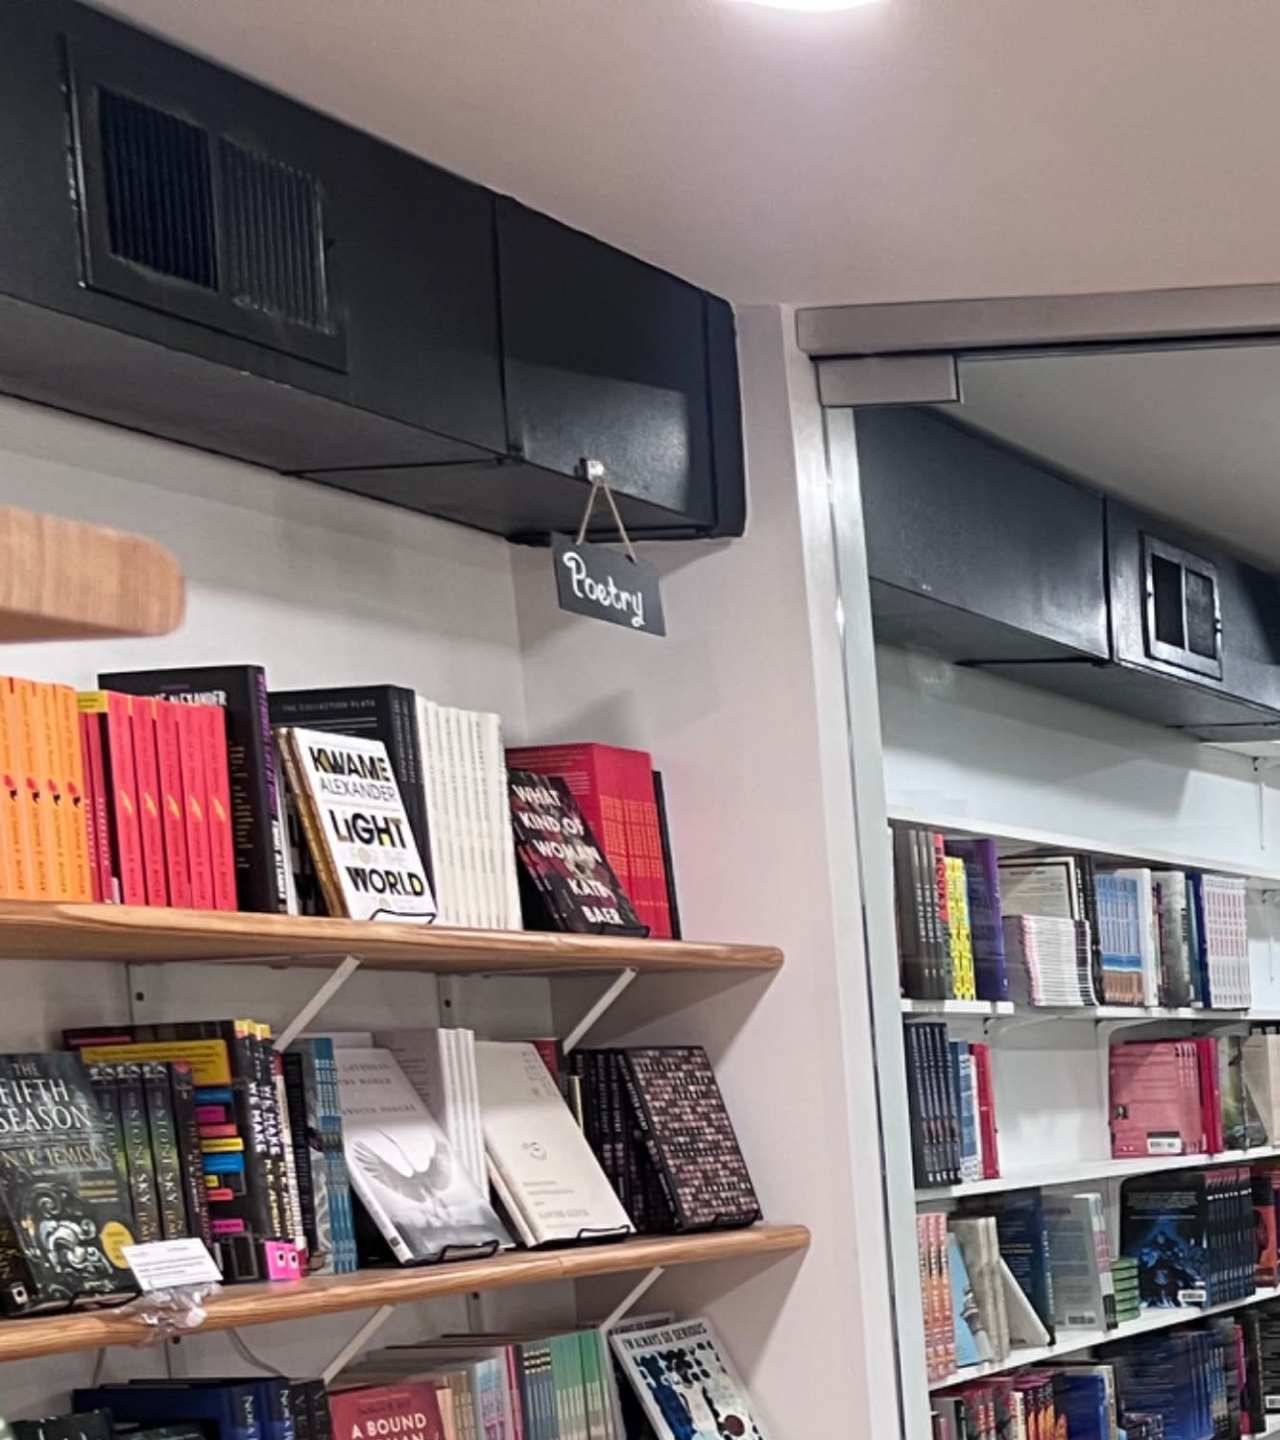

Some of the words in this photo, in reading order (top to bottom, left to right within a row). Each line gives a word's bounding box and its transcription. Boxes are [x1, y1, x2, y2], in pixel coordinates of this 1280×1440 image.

[563, 552, 645, 627] Poetry
[308, 745, 391, 783] KWAME
[320, 777, 397, 801] ALEXANDER
[511, 784, 562, 806] WHAT
[518, 811, 560, 834] KIND
[560, 816, 585, 836] OF
[533, 839, 603, 863] WOMAN
[345, 866, 424, 897] WORLD
[581, 905, 624, 925] BAER
[13, 1063, 41, 1076] THE
[249, 1082, 259, 1105] WE
[262, 1086, 274, 1112] WE
[252, 1111, 268, 1153] MAKE
[266, 1113, 282, 1155] MAKE
[45, 1143, 113, 1168] JEMISIN
[634, 1333, 660, 1348] ALWAYS
[662, 1331, 673, 1343] SO
[673, 1323, 707, 1340] SERIOUS
[352, 1424, 364, 1440] A
[366, 1413, 427, 1436] BOUND
